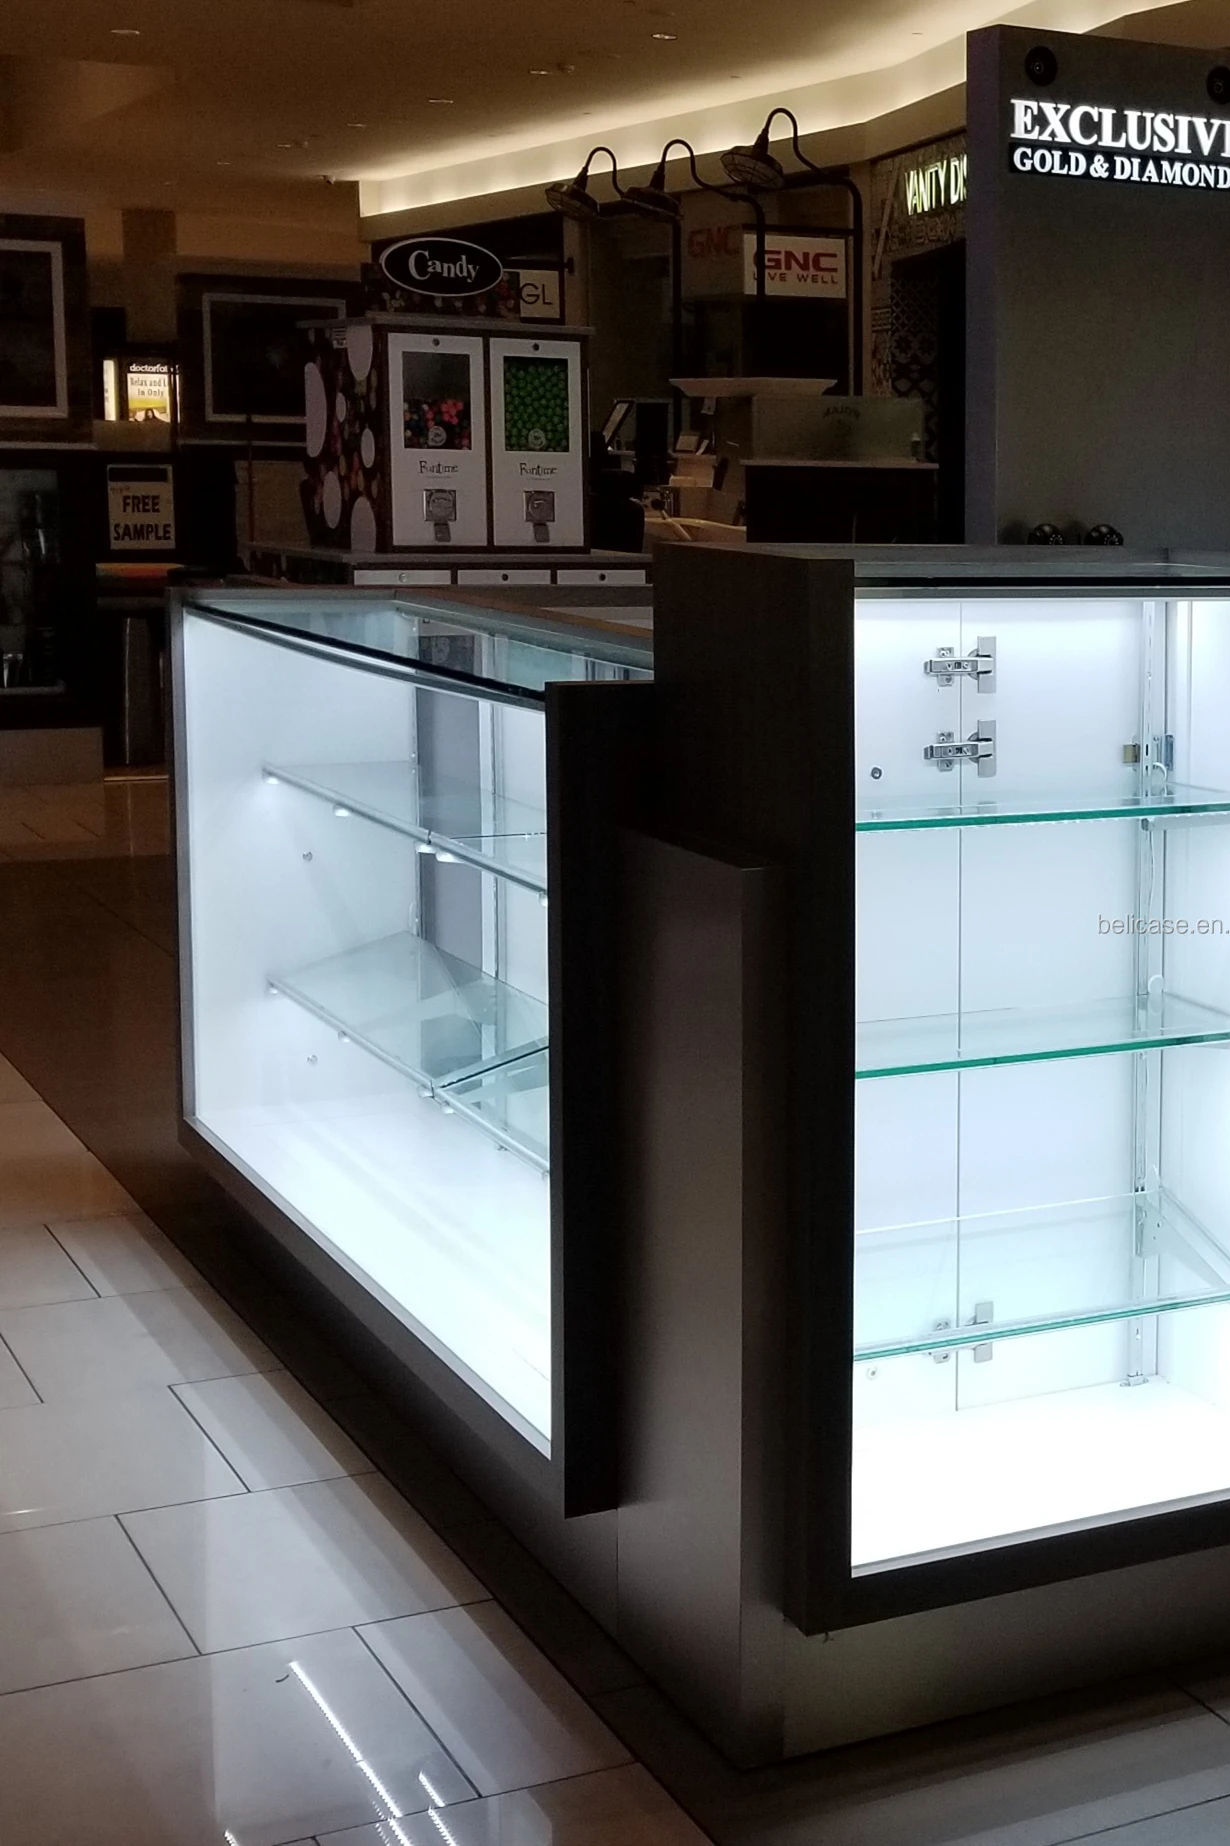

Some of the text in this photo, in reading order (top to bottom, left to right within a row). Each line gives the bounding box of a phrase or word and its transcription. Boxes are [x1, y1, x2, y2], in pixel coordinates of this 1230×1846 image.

[1013, 146, 1087, 176] GOLD
[1089, 154, 1109, 179] &
[905, 159, 948, 216] VANITY
[408, 249, 481, 284] Candy
[753, 250, 838, 273] GNC
[753, 272, 839, 285] LVE WELL
[519, 282, 554, 306] GL
[147, 388, 165, 397] Only
[149, 378, 162, 387] and
[123, 495, 160, 513] FREE
[113, 523, 171, 541] SAMPLE
